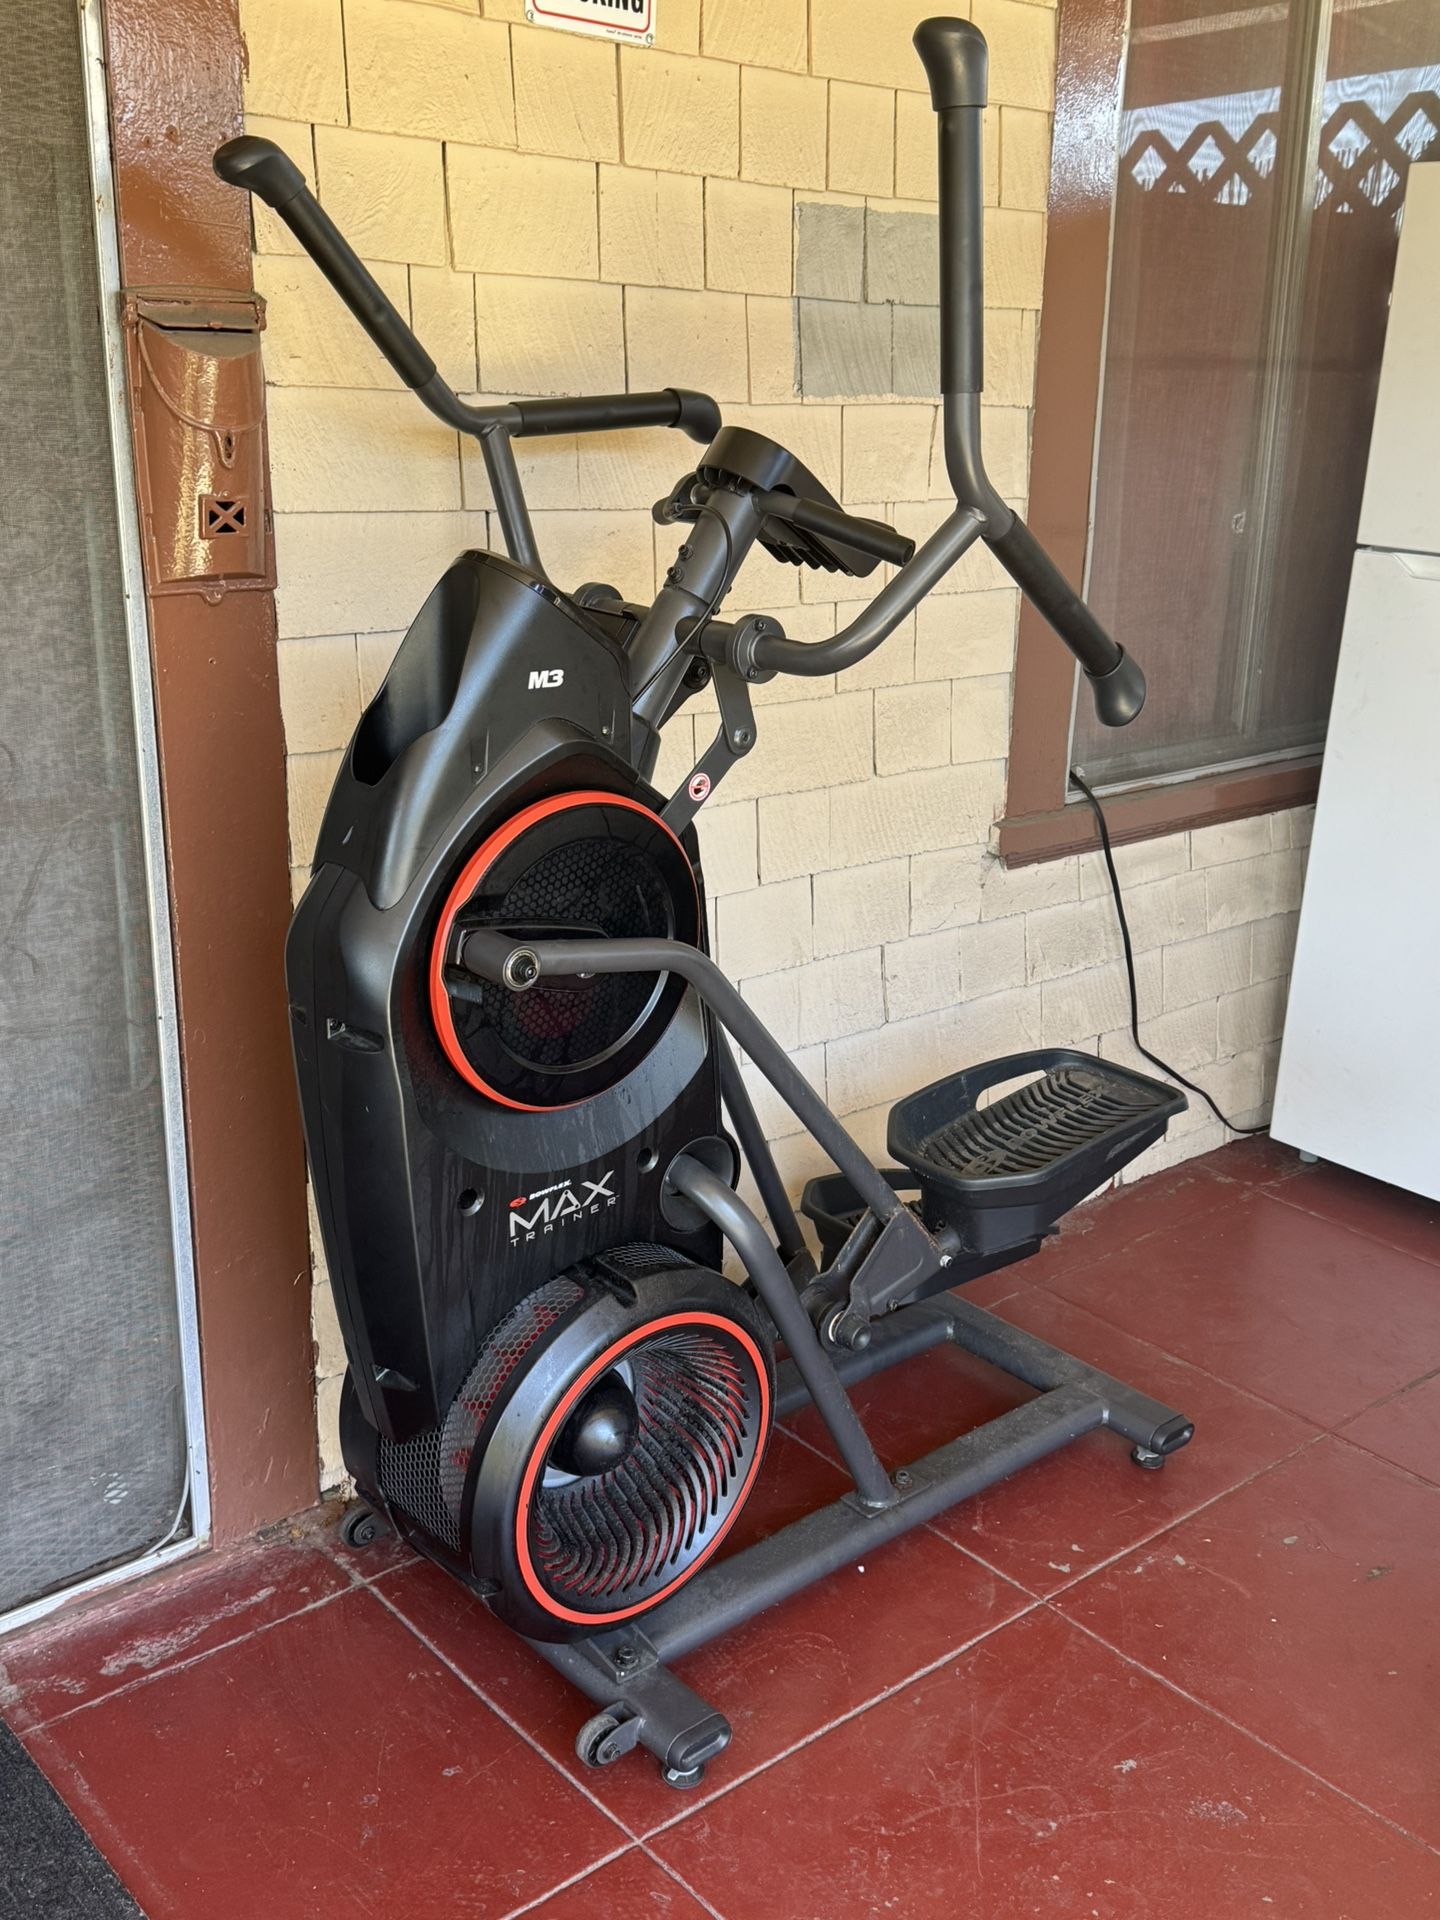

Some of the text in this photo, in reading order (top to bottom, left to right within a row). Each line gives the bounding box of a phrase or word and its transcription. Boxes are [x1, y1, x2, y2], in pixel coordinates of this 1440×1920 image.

[528, 669, 564, 690] M3
[509, 1169, 615, 1238] MAX
[529, 1179, 572, 1200] BOWFLEX
[510, 1196, 617, 1248] TRAINER
